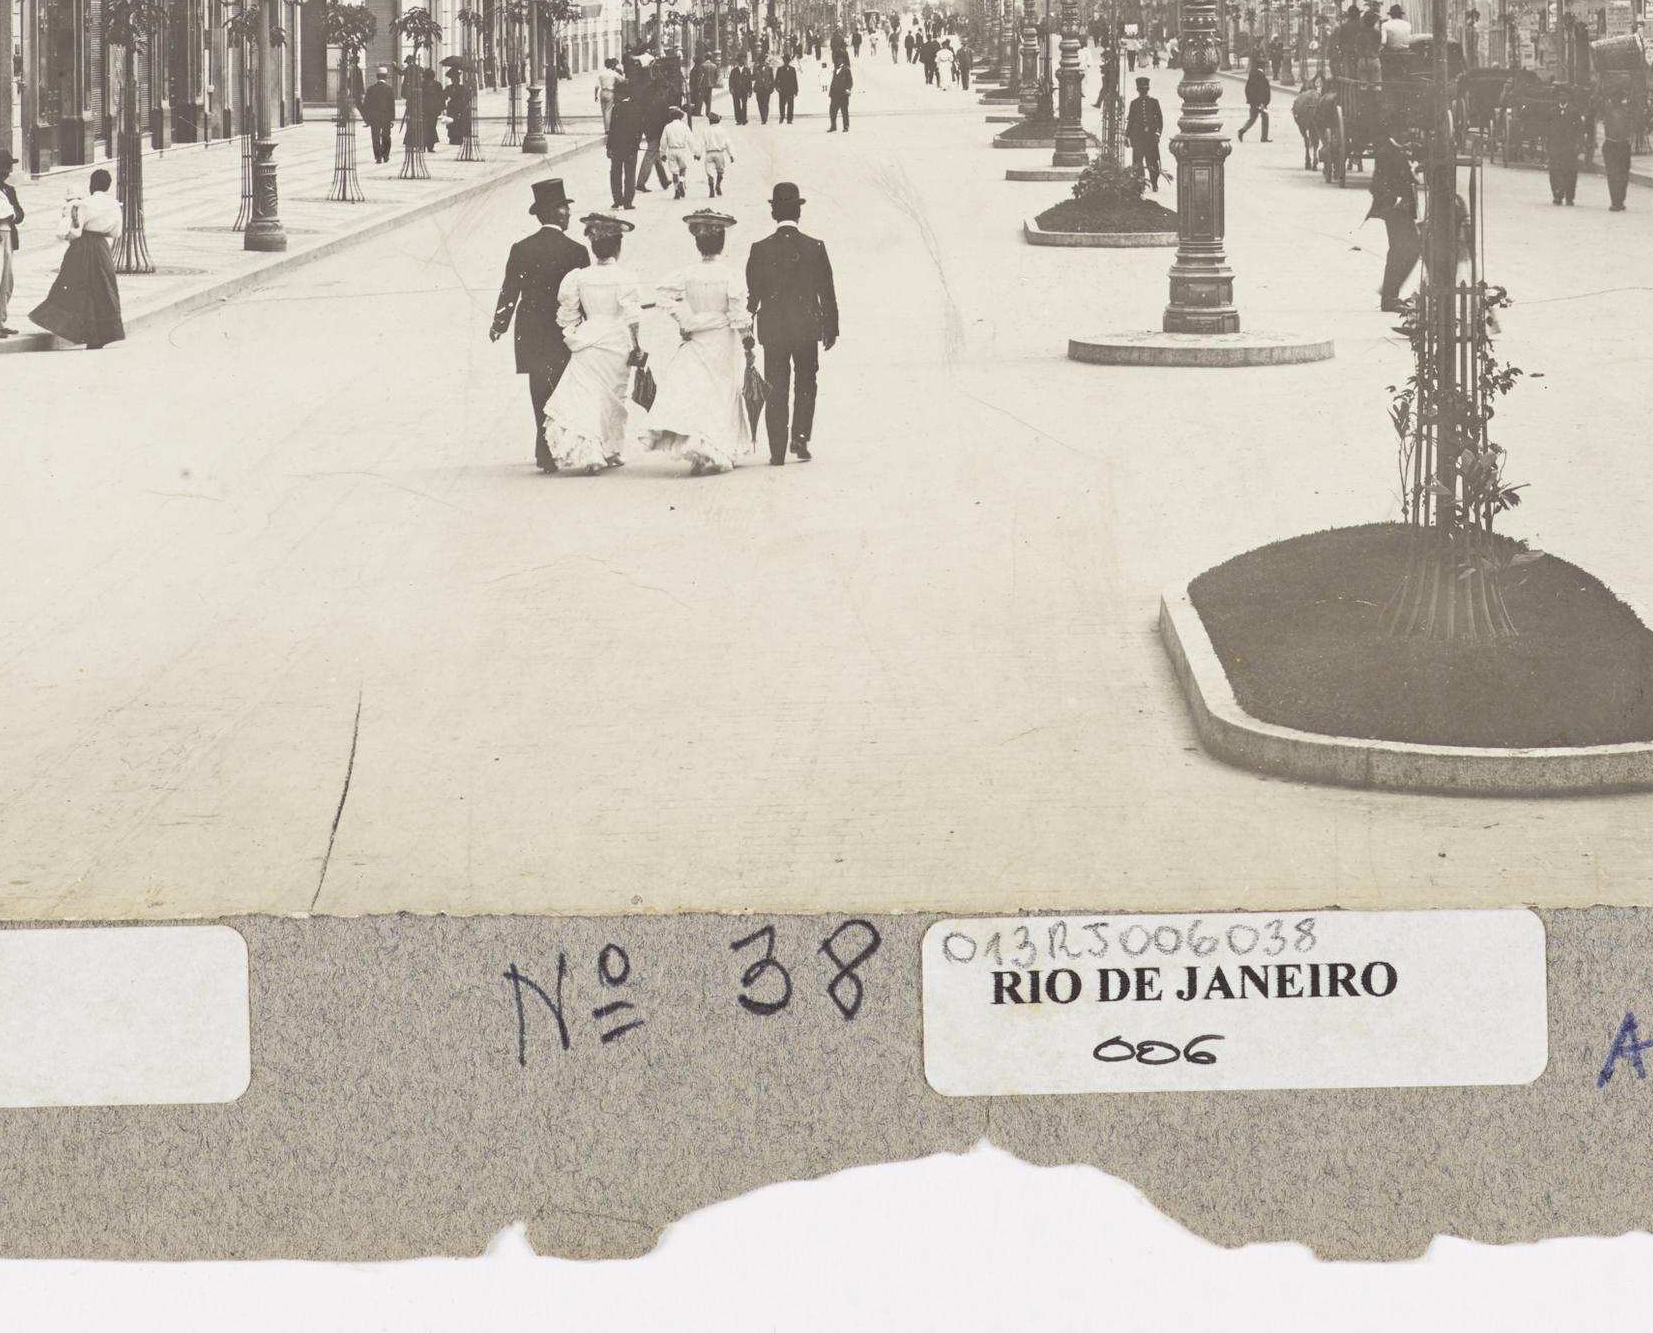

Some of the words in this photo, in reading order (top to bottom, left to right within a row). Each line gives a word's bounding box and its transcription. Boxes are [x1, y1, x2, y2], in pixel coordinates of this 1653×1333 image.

[731, 919, 882, 1020] 38
[989, 968, 1084, 1005] RIO
[1096, 967, 1164, 1002] DE
[1176, 961, 1399, 1001] JANEIRO
[1092, 1034, 1226, 1066] 006
